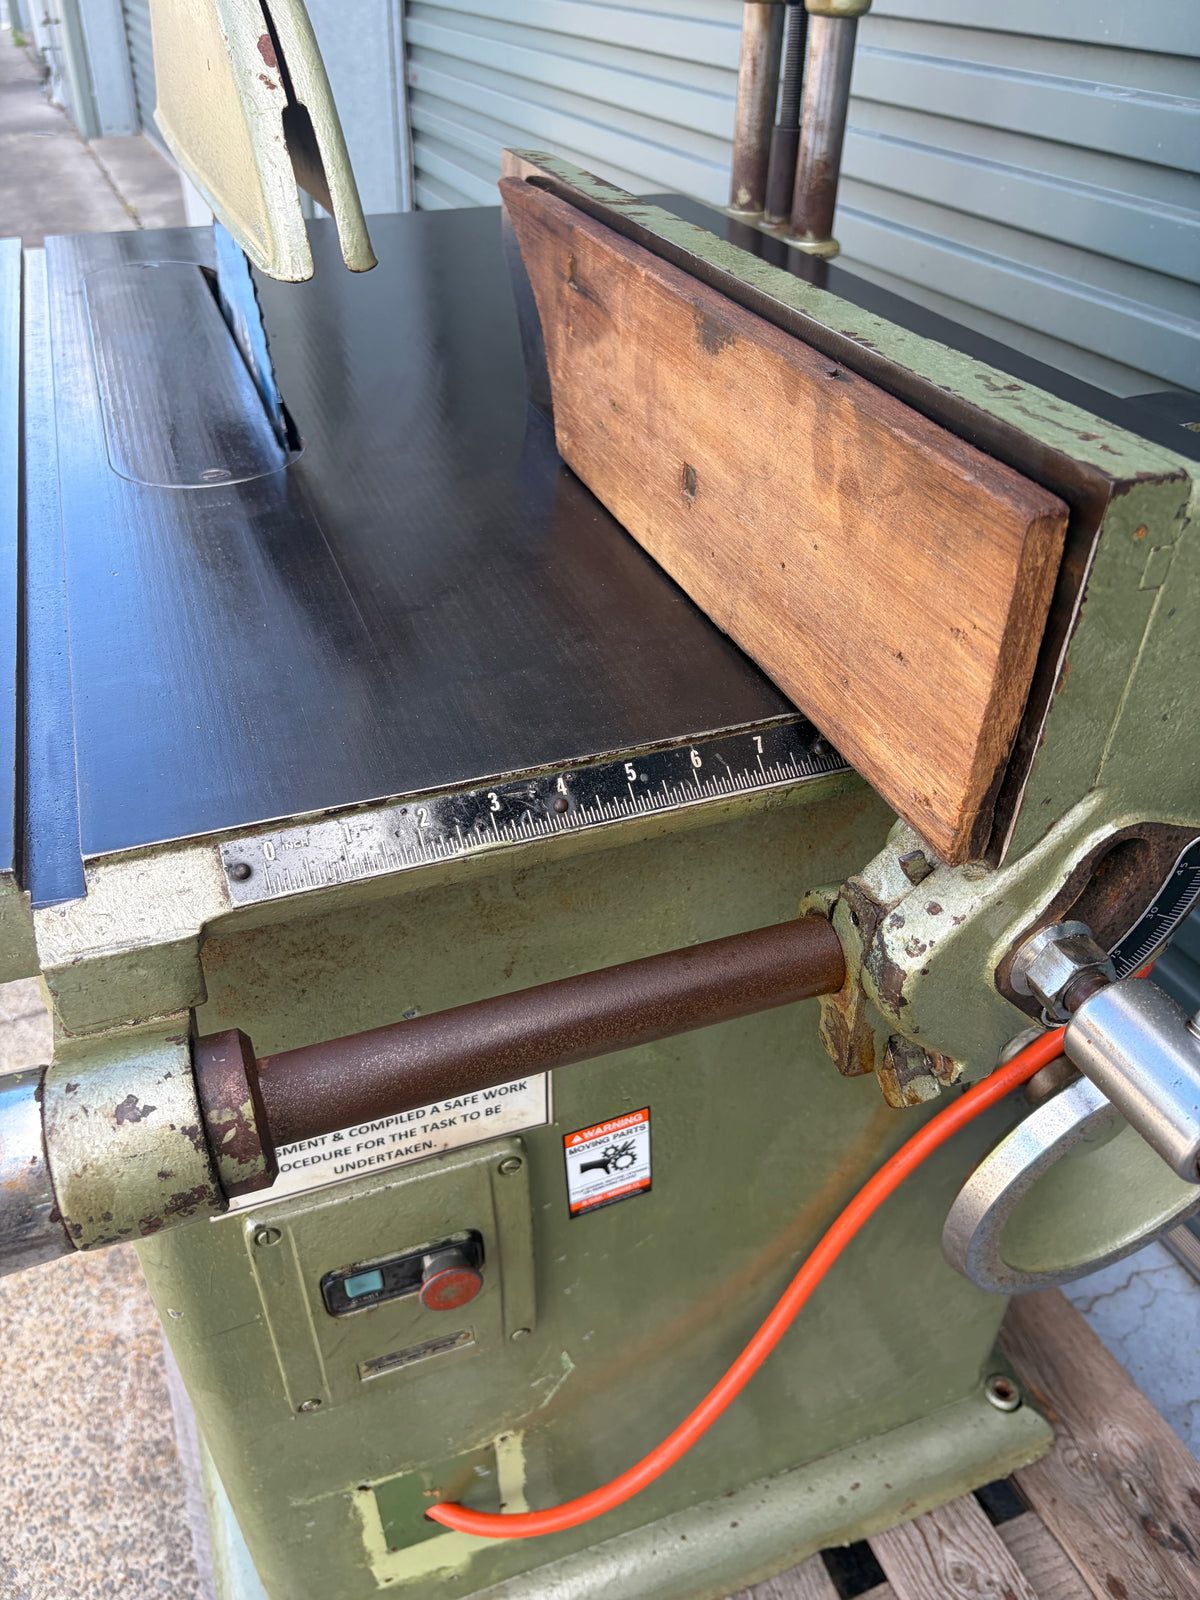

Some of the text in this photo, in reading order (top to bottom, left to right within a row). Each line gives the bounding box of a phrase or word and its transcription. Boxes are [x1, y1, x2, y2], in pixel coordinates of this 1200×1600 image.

[263, 735, 763, 861] 0 INCH 1 2 3 4 5 6 7
[1176, 862, 1188, 876] 45
[1146, 906, 1159, 920] 30
[1111, 949, 1122, 959] 15
[332, 1132, 344, 1142] &
[348, 1109, 426, 1138] COMPILED
[430, 1105, 440, 1115] A
[444, 1094, 479, 1111] SAFE
[482, 1081, 528, 1101] WORK
[582, 1113, 644, 1140] WARNING
[356, 1137, 385, 1153] FOR
[389, 1128, 417, 1143] THE
[421, 1117, 458, 1134] TASK
[461, 1110, 480, 1123] TO
[485, 1104, 502, 1117] BE
[568, 1123, 647, 1156] MOVING PARTS
[333, 1139, 437, 1175] UNDERTAKEN.
